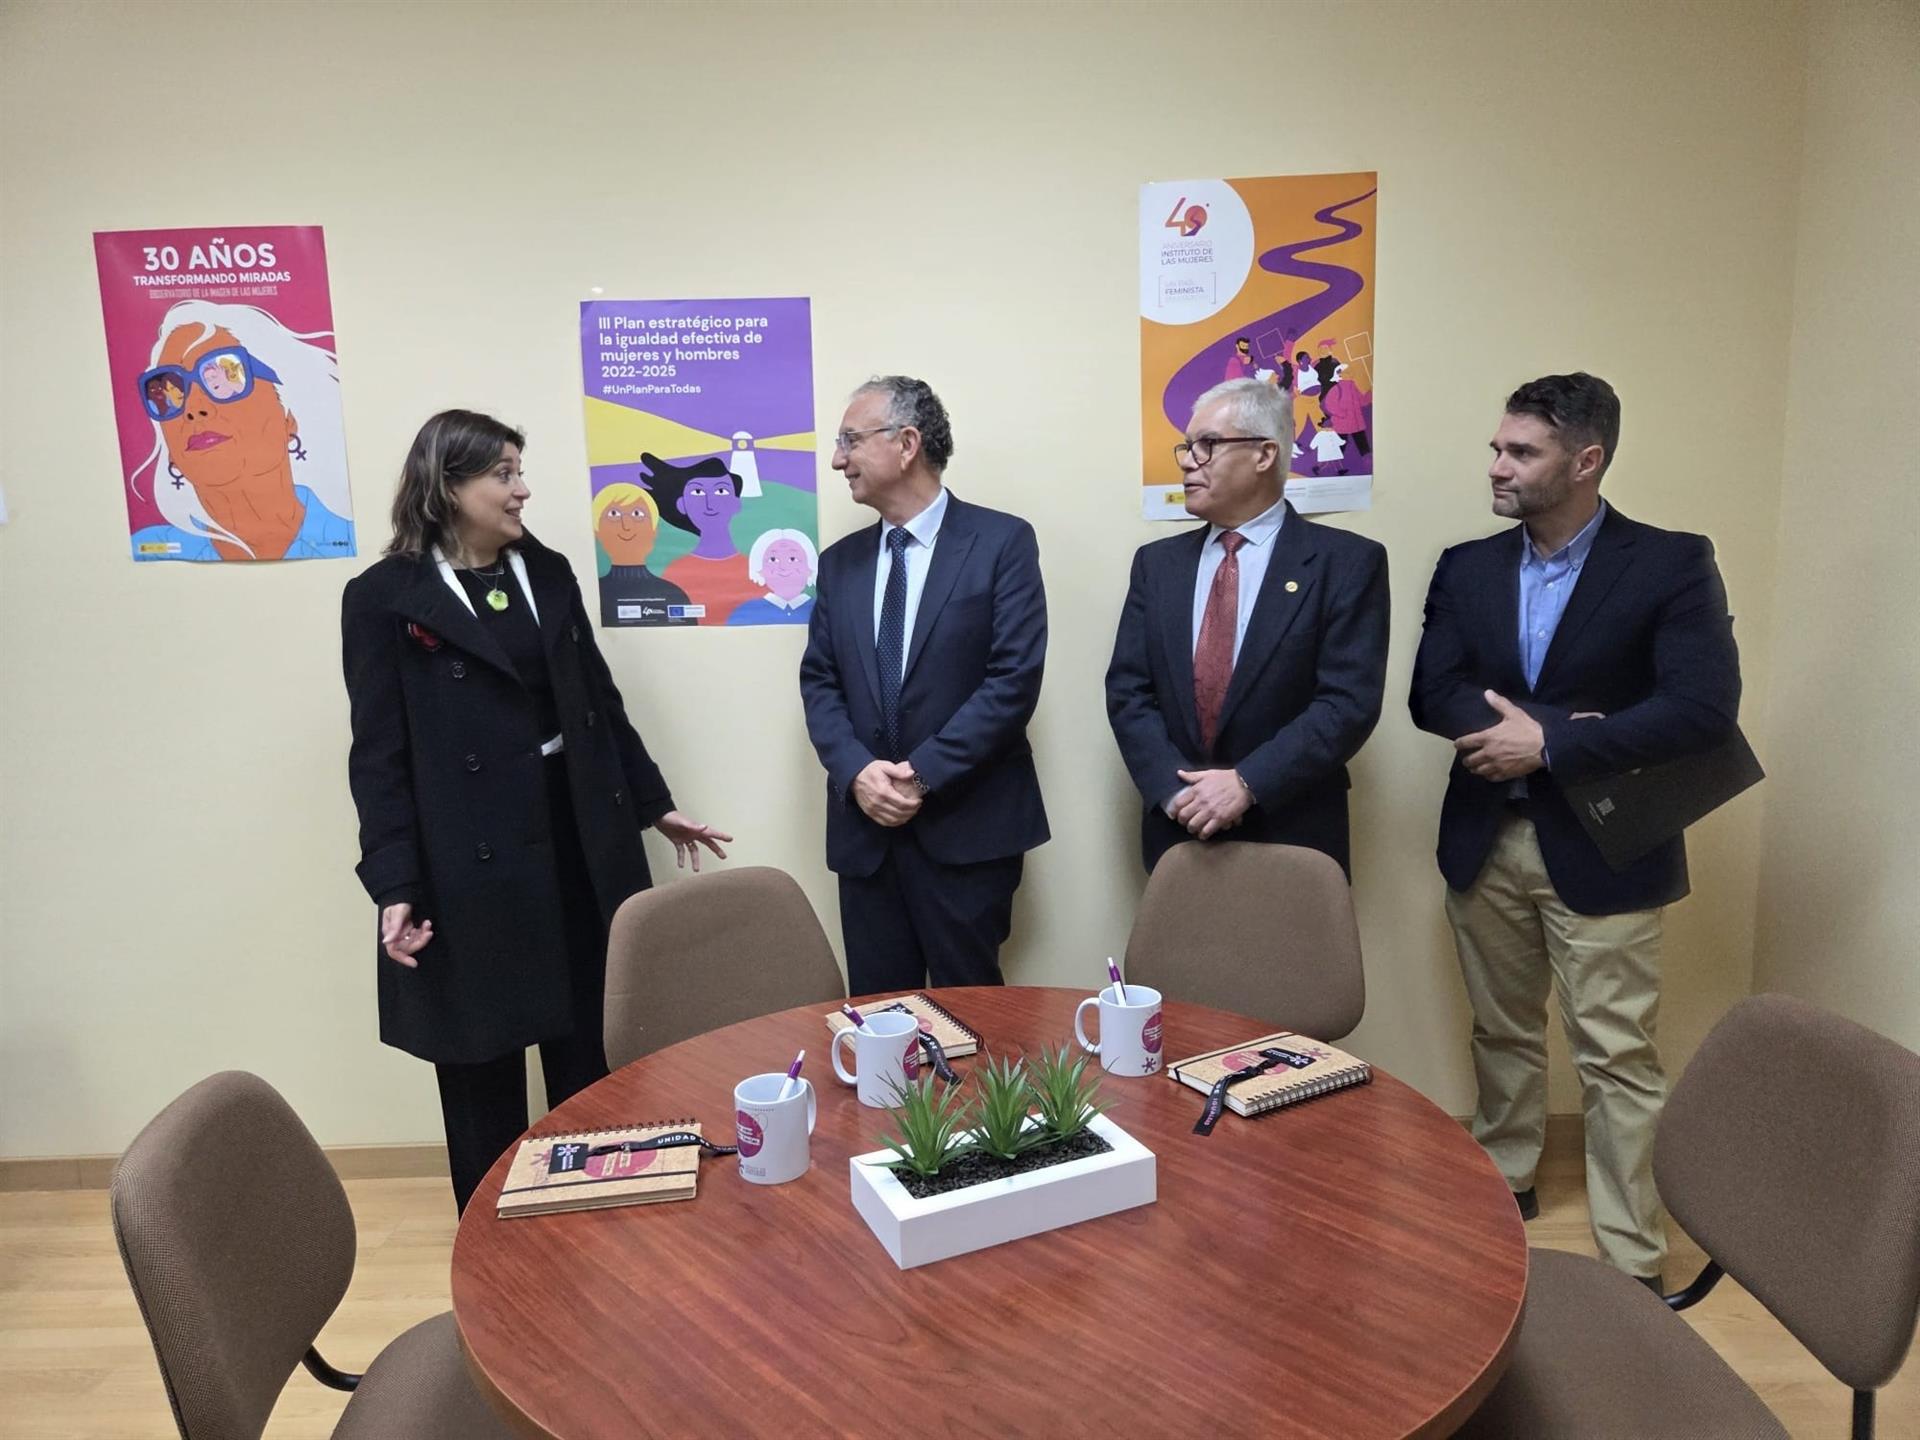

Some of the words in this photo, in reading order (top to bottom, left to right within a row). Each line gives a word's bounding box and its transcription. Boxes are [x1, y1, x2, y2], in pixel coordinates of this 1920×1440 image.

[143, 246, 180, 271] 30
[188, 237, 277, 270] AÑOS
[1161, 249, 1201, 257] INSTITUTO
[1203, 248, 1213, 256] DE
[1178, 256, 1213, 264] MUJERES
[133, 273, 237, 286] TRANSFORMANDO
[239, 271, 291, 284] MIRADAS
[598, 317, 611, 329] III
[614, 317, 645, 329] Plan
[648, 316, 732, 331] estratégico
[735, 316, 768, 330] para
[599, 333, 612, 345] la
[616, 332, 678, 348] igualdad
[682, 331, 740, 344] efectiva
[744, 331, 763, 343] de
[601, 349, 660, 364] mujeres
[663, 351, 672, 363] y
[675, 348, 740, 361] hombres
[602, 365, 677, 378] 2022-2025
[603, 384, 701, 395] #UnPlanParaTodas
[657, 1134, 697, 1145] UNIDAD
